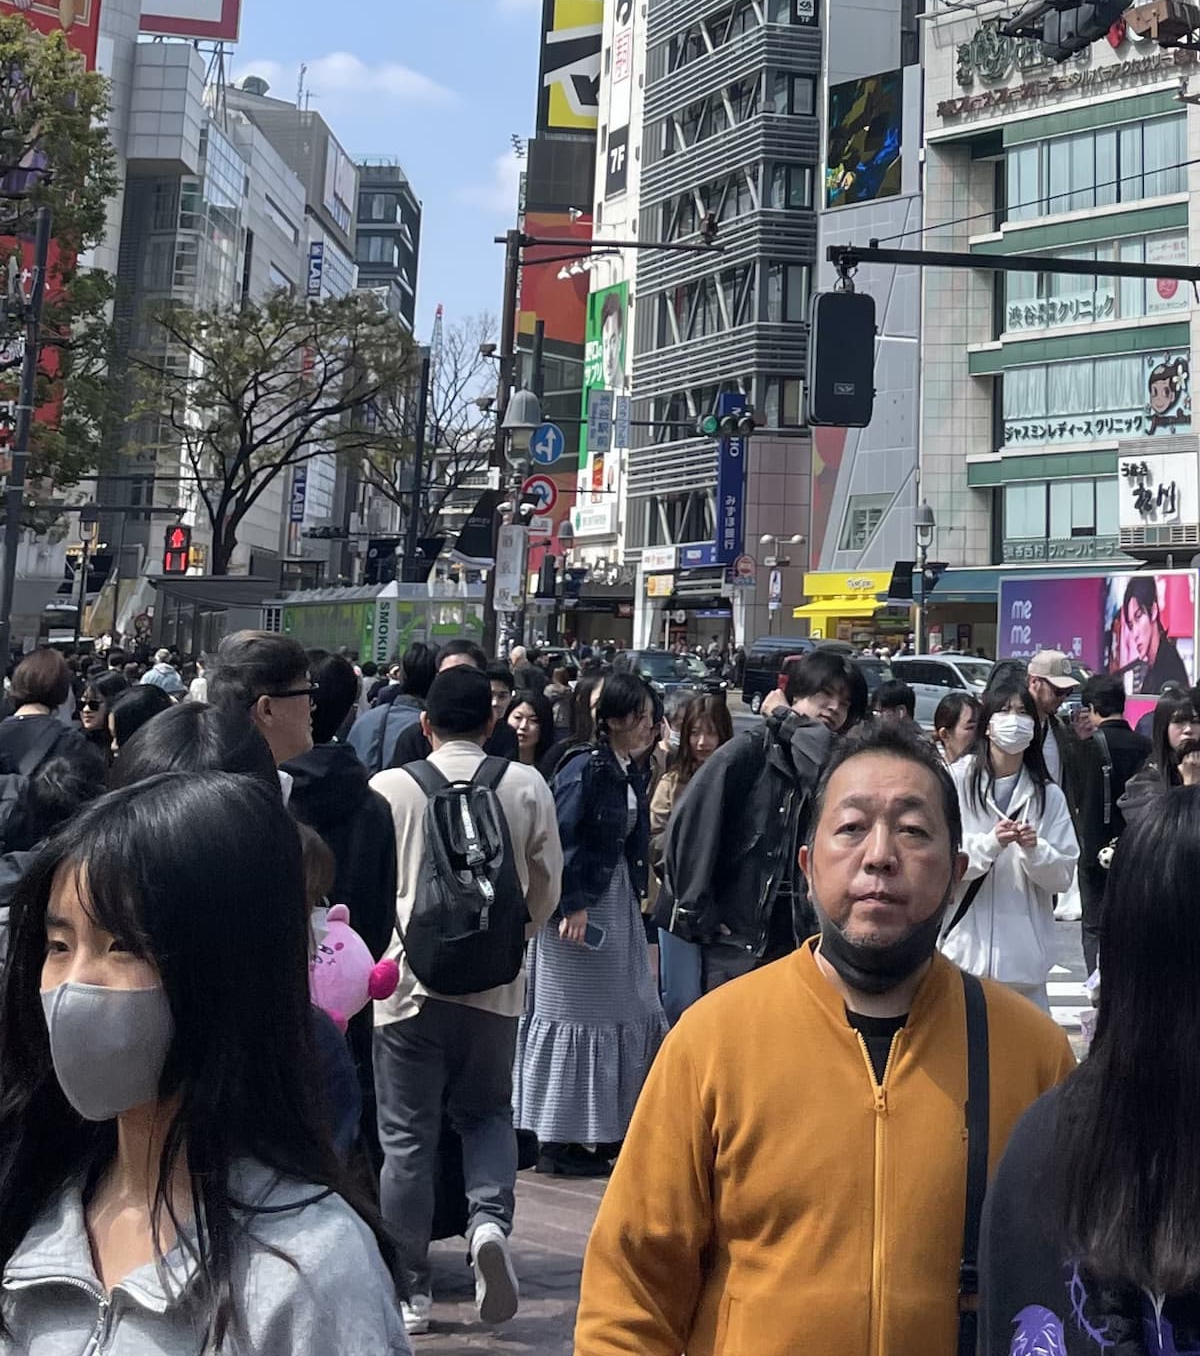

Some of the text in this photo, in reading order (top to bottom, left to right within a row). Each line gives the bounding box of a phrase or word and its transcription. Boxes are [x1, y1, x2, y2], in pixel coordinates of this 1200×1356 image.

[610, 146, 625, 174] 7F
[1095, 415, 1143, 434] クリニック
[377, 602, 390, 665] SMOKIN
